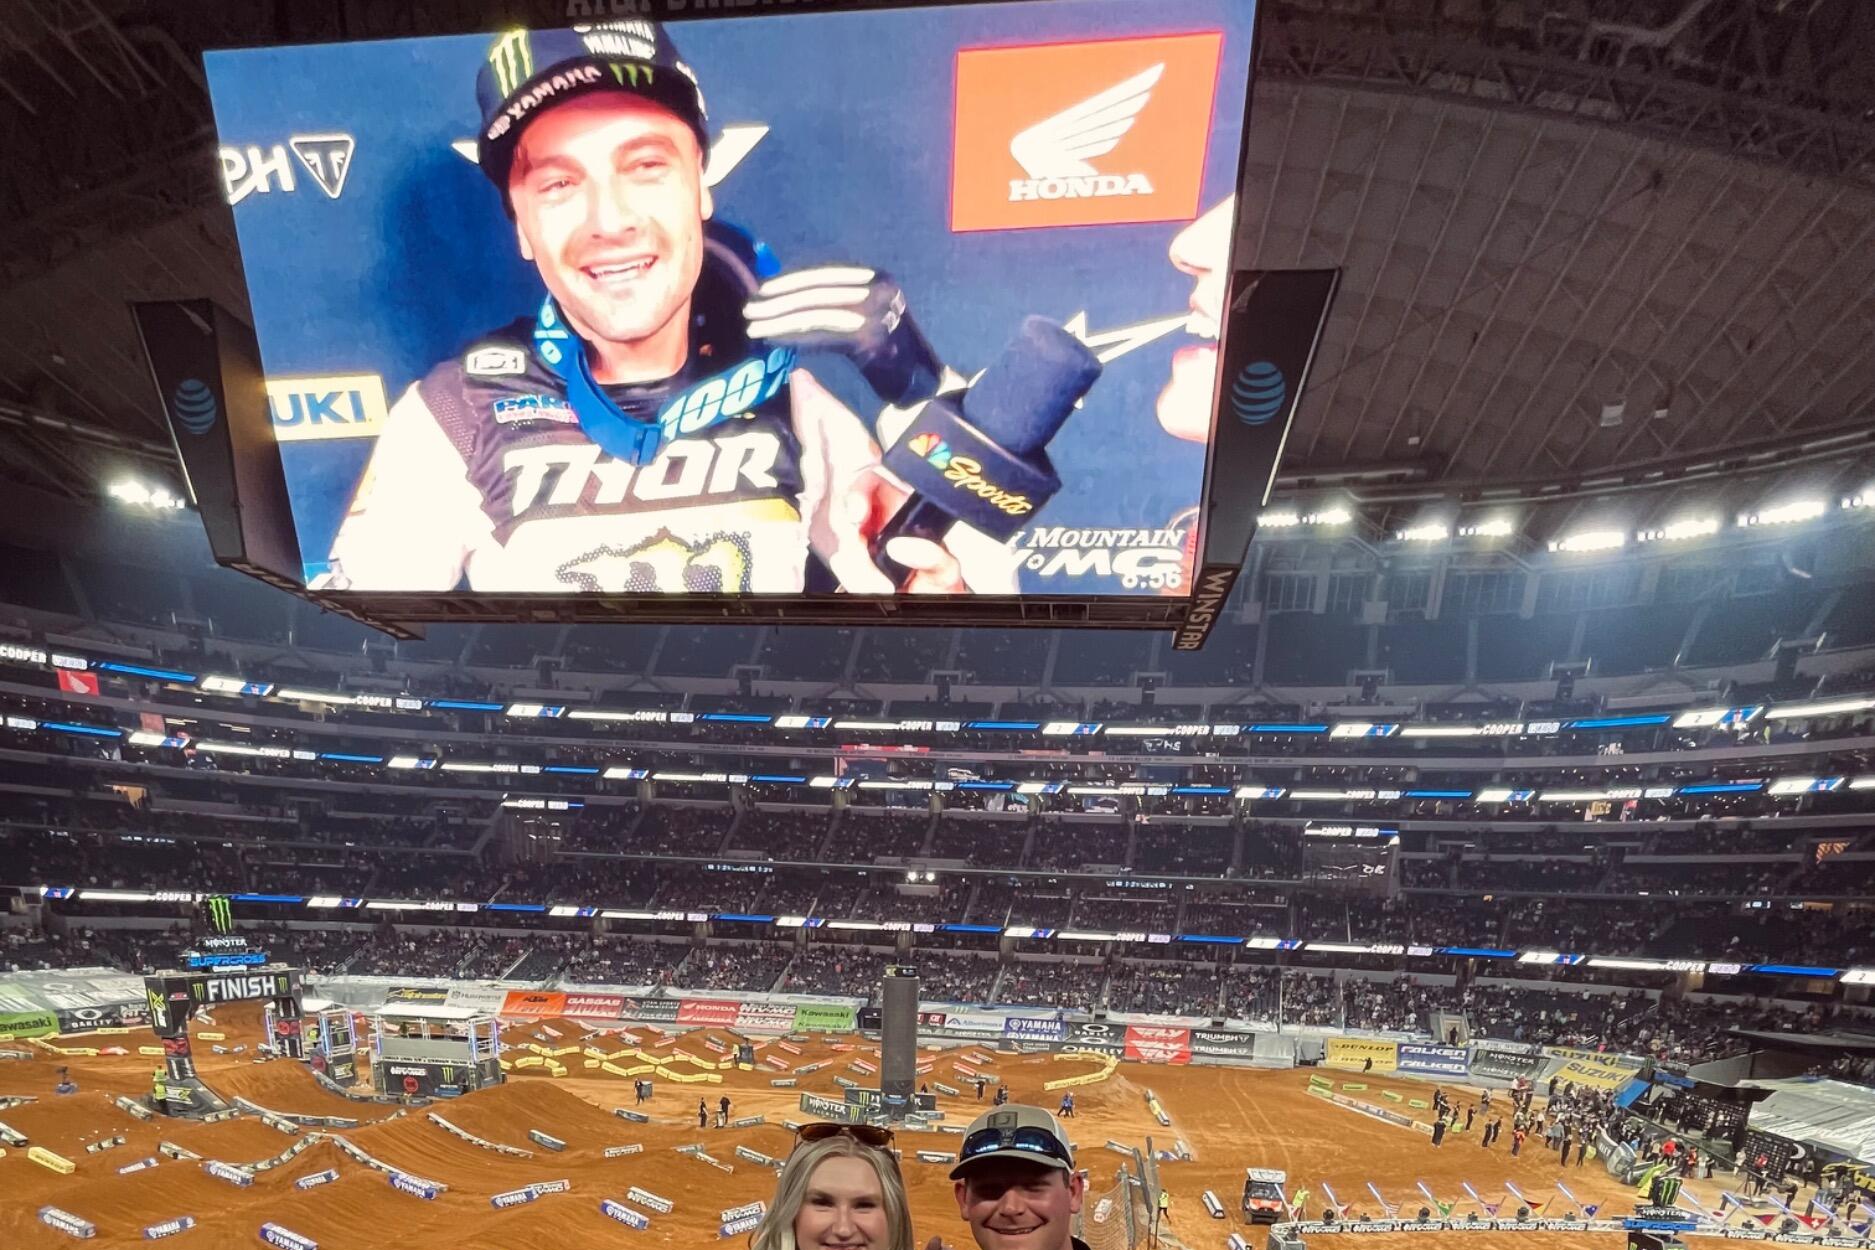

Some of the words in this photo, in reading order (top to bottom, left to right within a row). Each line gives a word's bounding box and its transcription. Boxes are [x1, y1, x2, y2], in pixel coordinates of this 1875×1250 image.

[507, 65, 602, 119] YAMAHA
[1008, 172, 1155, 202] HONDA
[504, 432, 780, 516] THOR
[944, 456, 1033, 516] Sports
[1027, 527, 1189, 549] MOUNTAIN
[1177, 570, 1233, 651] WINSTAR
[0, 646, 47, 663] COOPER
[357, 696, 392, 707] COOPER
[635, 711, 667, 721] COOPER
[901, 721, 933, 731] COOPER
[1176, 725, 1210, 736] COOPER
[1483, 724, 1524, 735] COOPER
[205, 938, 247, 947] MONSTER
[207, 975, 277, 1001] FINISH
[696, 1004, 737, 1012] HONDA
[801, 1009, 850, 1019] Kawasaki
[71, 1018, 113, 1029] OAKLEY
[1021, 1020, 1061, 1030] YAMAHA
[1074, 1030, 1115, 1038] OAKLEY
[1195, 1032, 1239, 1042] TRIUMPH
[1340, 1043, 1394, 1052] DUNLOP
[1400, 1045, 1466, 1057] FALKEN
[1489, 1052, 1535, 1065] MONSTER
[1400, 1060, 1466, 1070] FALKEN
[1567, 1061, 1629, 1082] SUZUKI
[810, 1097, 846, 1114] MONSTER
